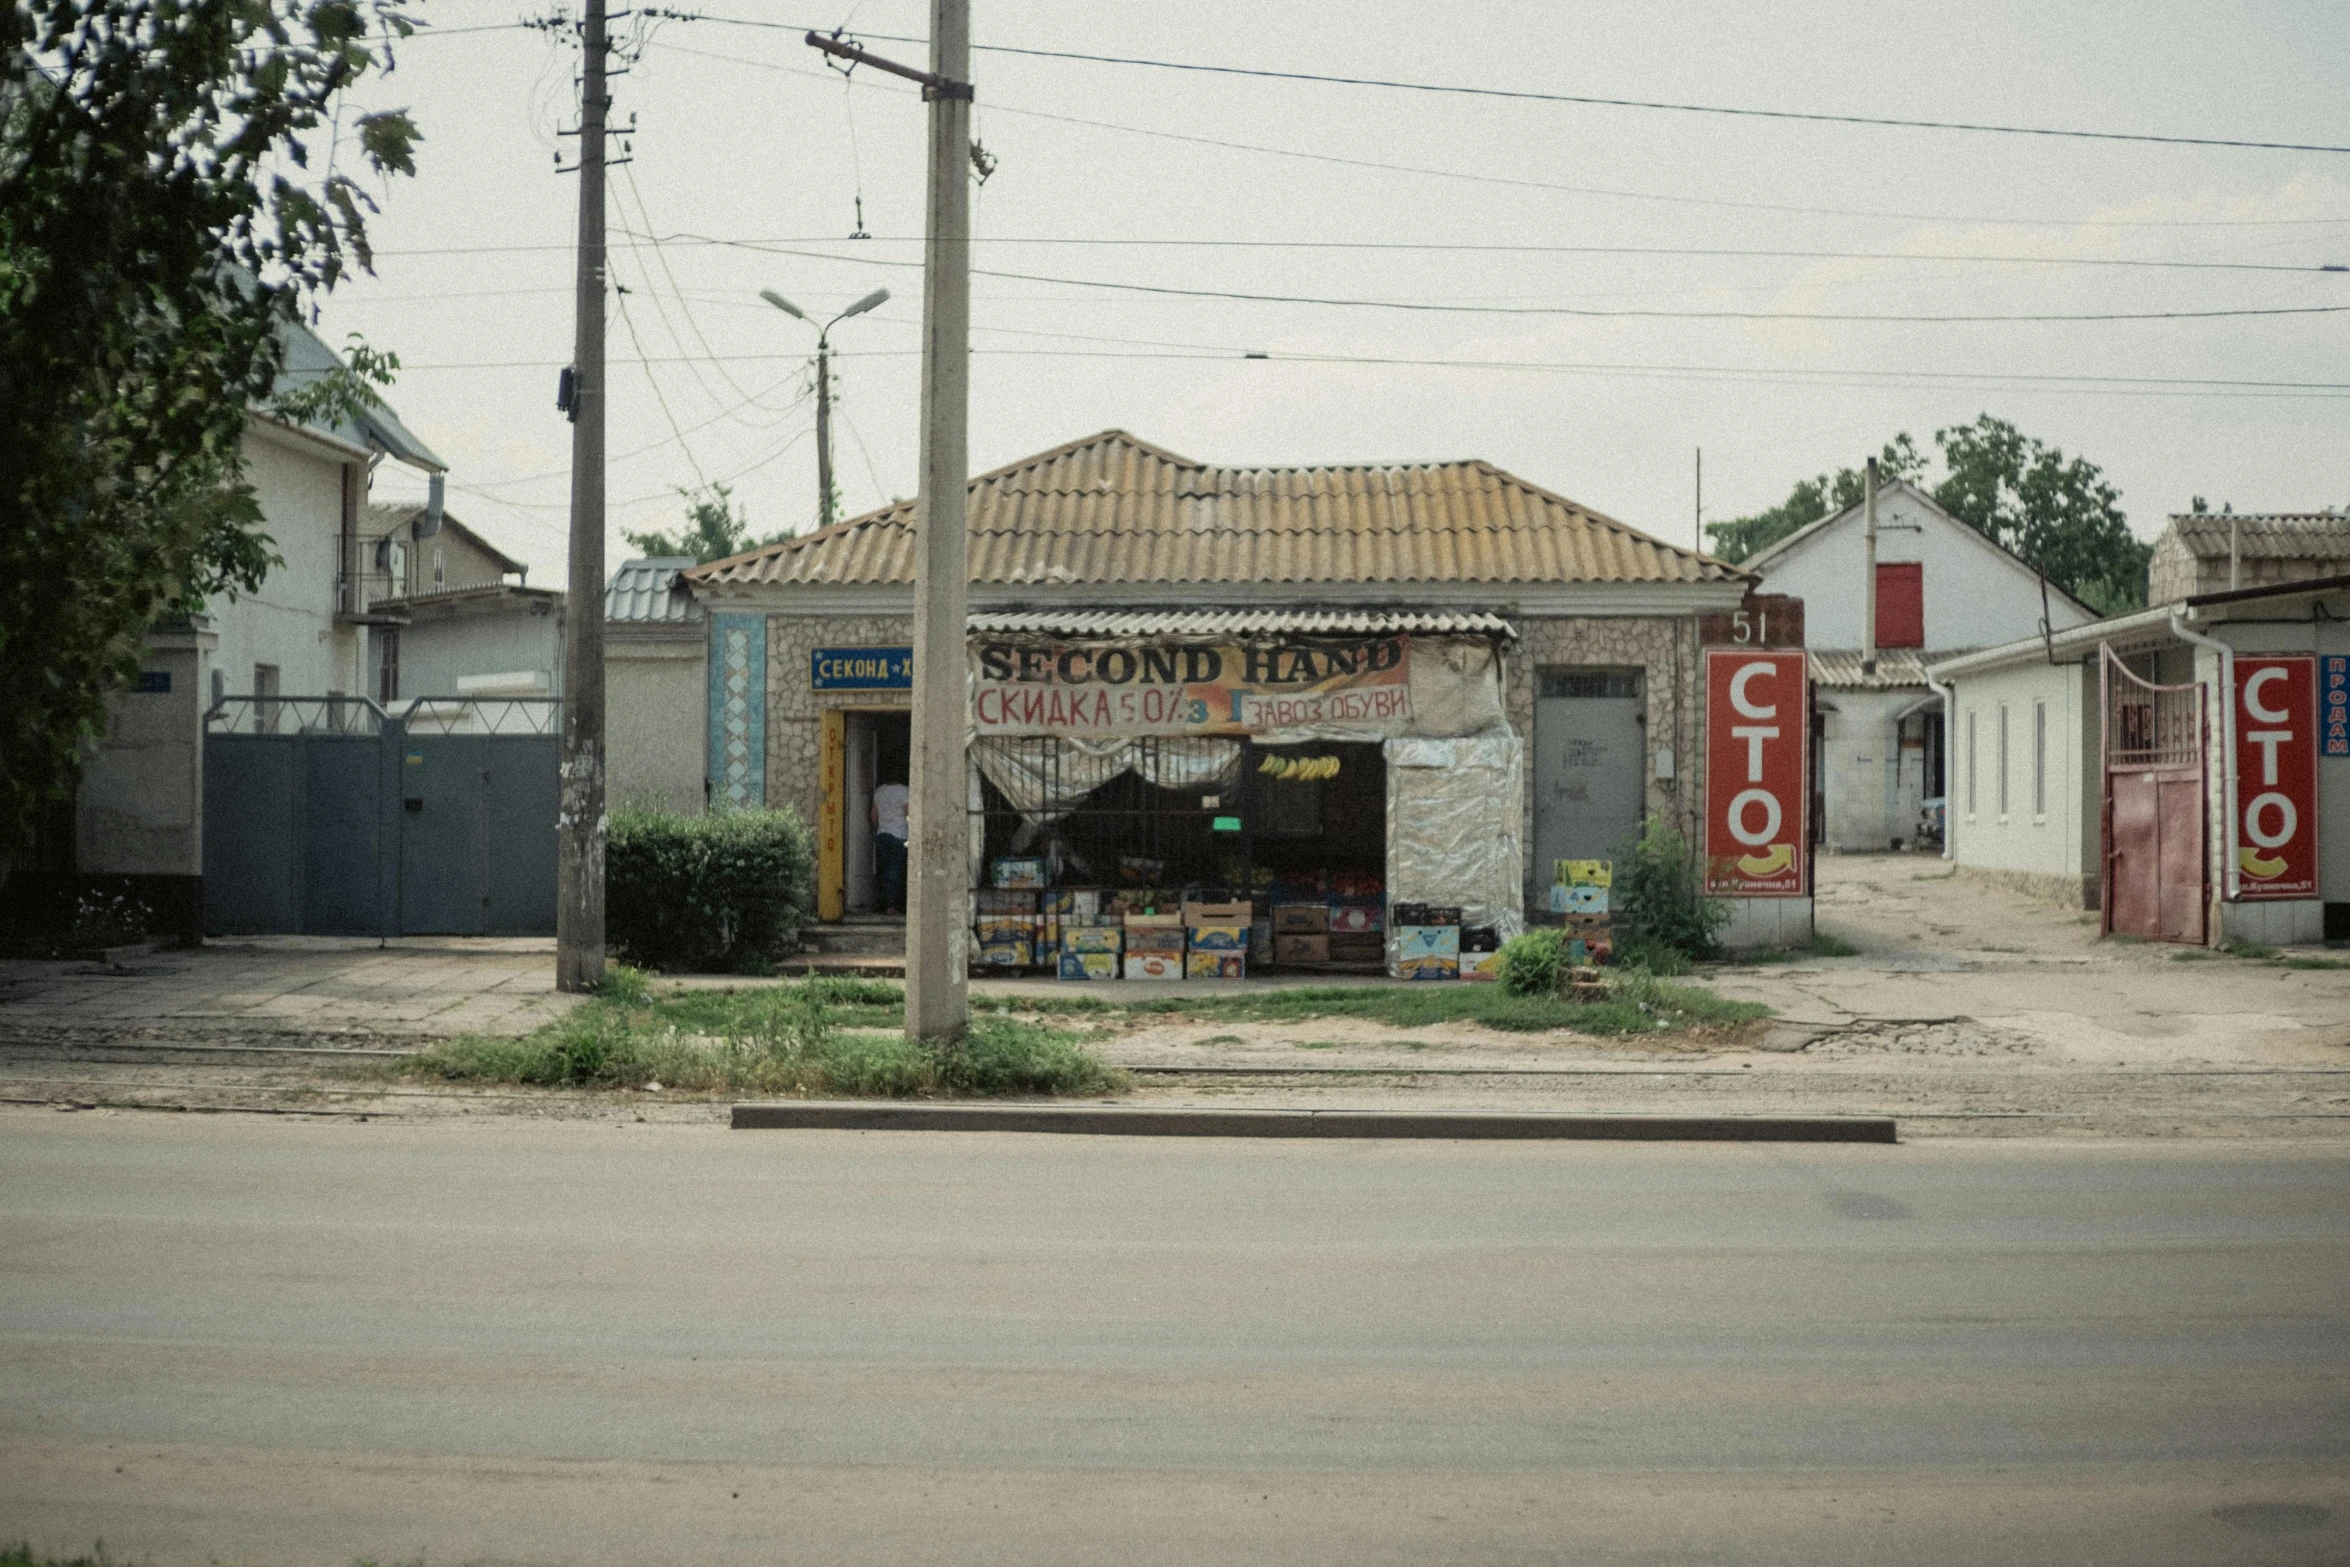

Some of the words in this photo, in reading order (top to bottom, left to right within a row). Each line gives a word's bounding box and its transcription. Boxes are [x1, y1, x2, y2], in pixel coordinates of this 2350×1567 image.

[1732, 611, 1766, 643] 51
[819, 659, 889, 678] СЕКОНД
[979, 643, 1223, 685] SECOND
[1241, 639, 1402, 684] HAND
[978, 688, 1112, 726] СКИДКА
[1120, 686, 1184, 724] 50%
[1248, 699, 1322, 727] ЗАВОЗ
[1331, 689, 1407, 721] ОБУВИ
[2327, 657, 2348, 754] ПРОДАМ
[1728, 661, 1782, 846] СТО
[2244, 666, 2298, 848] СТО
[827, 727, 836, 851] ОТКРЫТО
